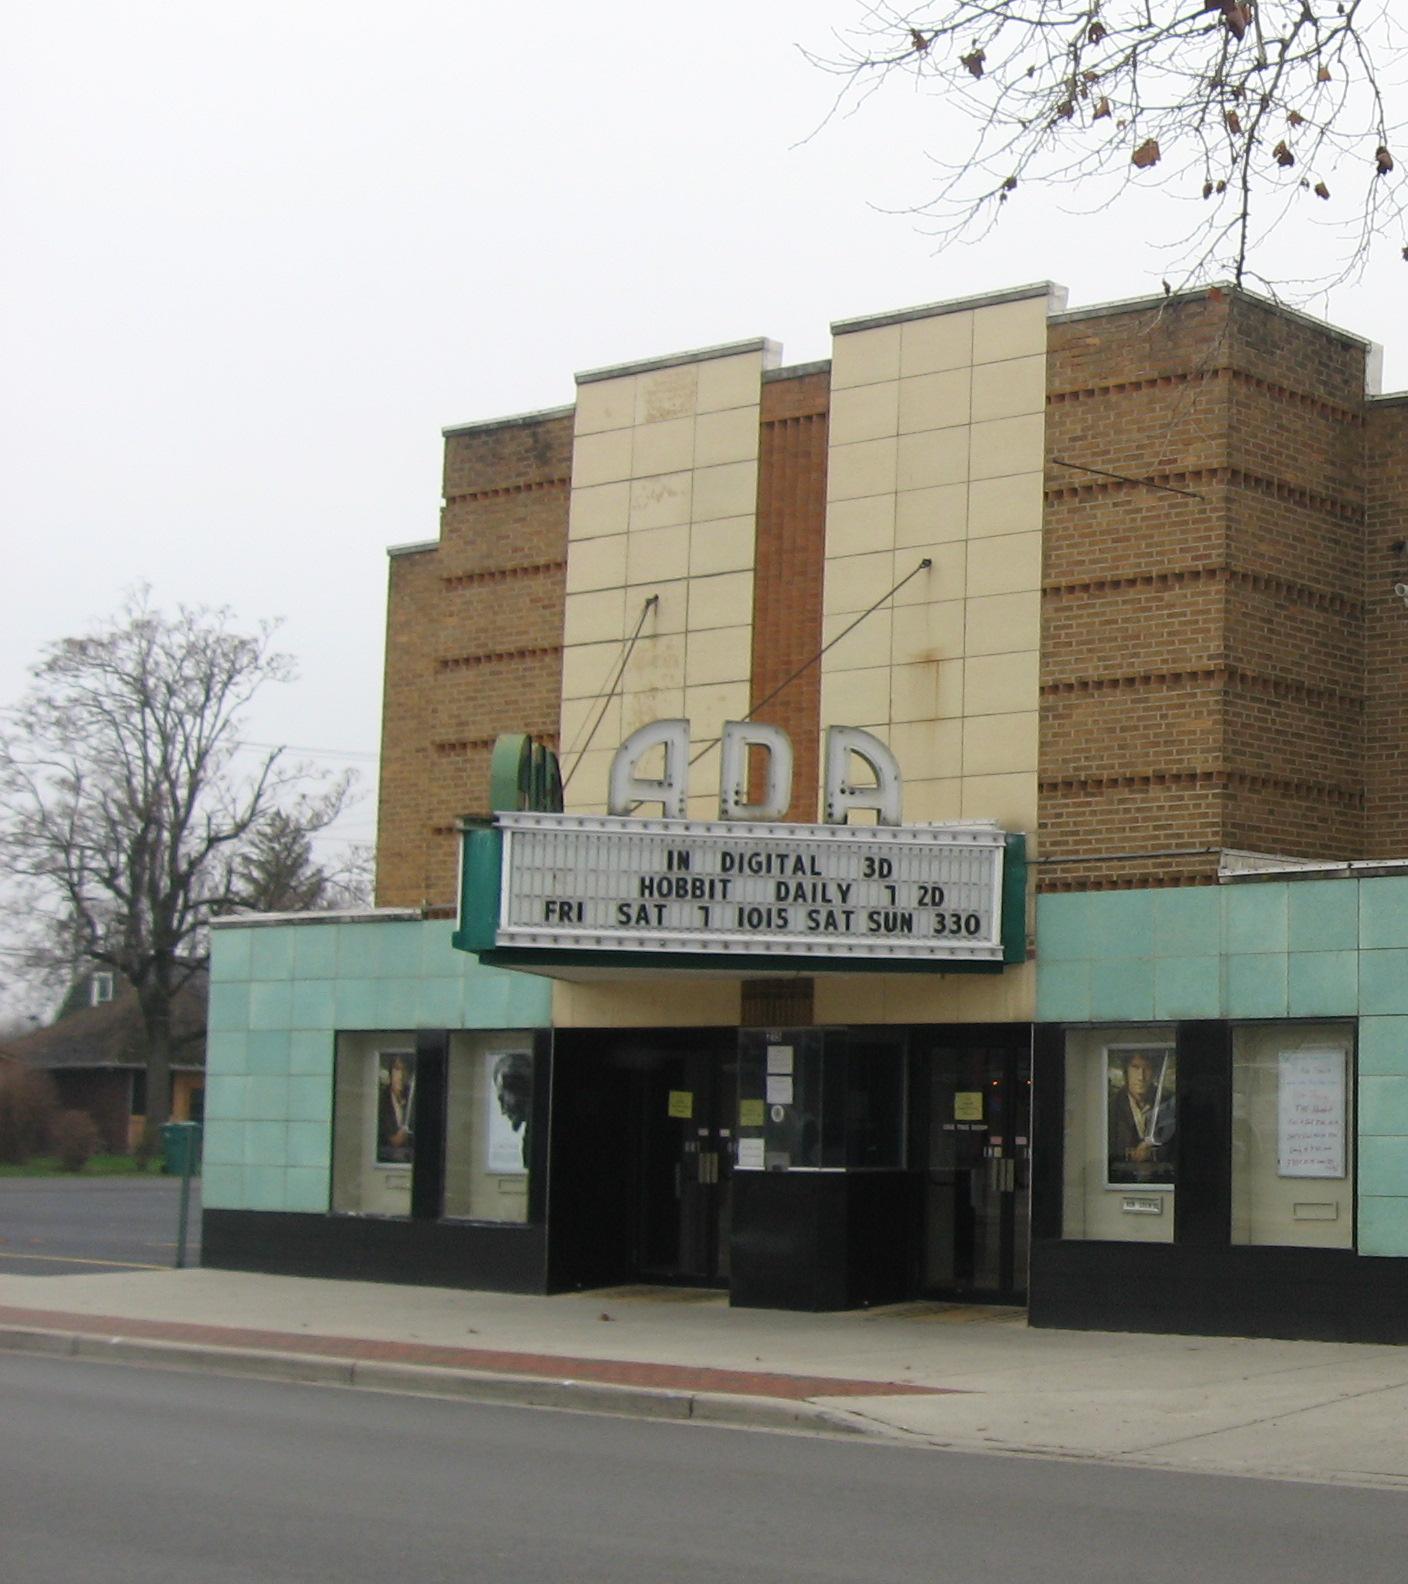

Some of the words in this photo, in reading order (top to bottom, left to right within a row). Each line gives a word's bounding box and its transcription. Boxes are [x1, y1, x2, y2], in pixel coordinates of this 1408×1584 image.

[607, 718, 902, 826] ADA
[667, 849, 691, 872] IN
[721, 851, 822, 876] DIGITAL
[863, 857, 893, 879] 3D
[640, 876, 732, 899] HOBBIT
[776, 881, 852, 904] DAILY
[884, 885, 897, 906] 7
[917, 886, 945, 907] 2D
[544, 901, 584, 923] FRI
[617, 903, 669, 926] SAT
[698, 906, 710, 927] 7
[738, 907, 789, 930] 1015
[807, 909, 855, 931] SAT
[868, 911, 914, 934] SUN
[933, 913, 981, 936] 330
